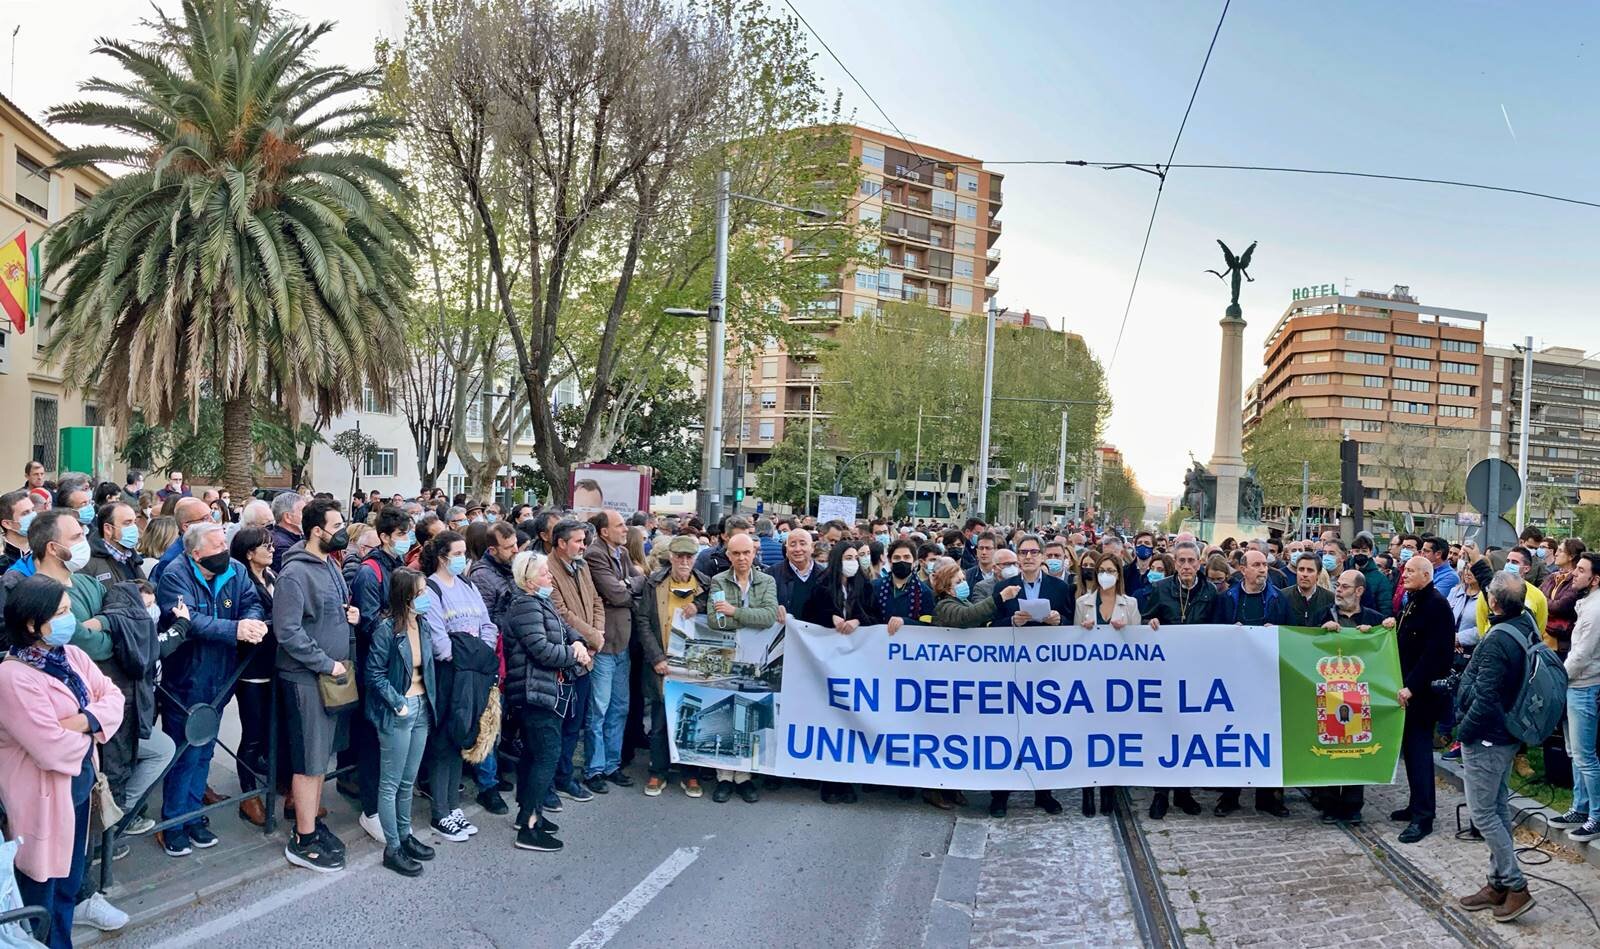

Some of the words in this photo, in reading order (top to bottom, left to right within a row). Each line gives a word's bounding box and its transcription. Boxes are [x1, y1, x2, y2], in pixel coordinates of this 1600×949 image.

[1292, 283, 1339, 301] HOTEL
[888, 642, 1032, 663] PLATAFORMA
[1035, 642, 1166, 662] CIUDADANA
[826, 677, 880, 713] EN
[895, 678, 1095, 715] DEFENSA
[1105, 678, 1164, 714] DE
[1178, 678, 1235, 714] LA
[787, 723, 1073, 771] UNIVERSIDAD
[1087, 732, 1144, 768] DE
[1157, 723, 1271, 769] JAÉN
